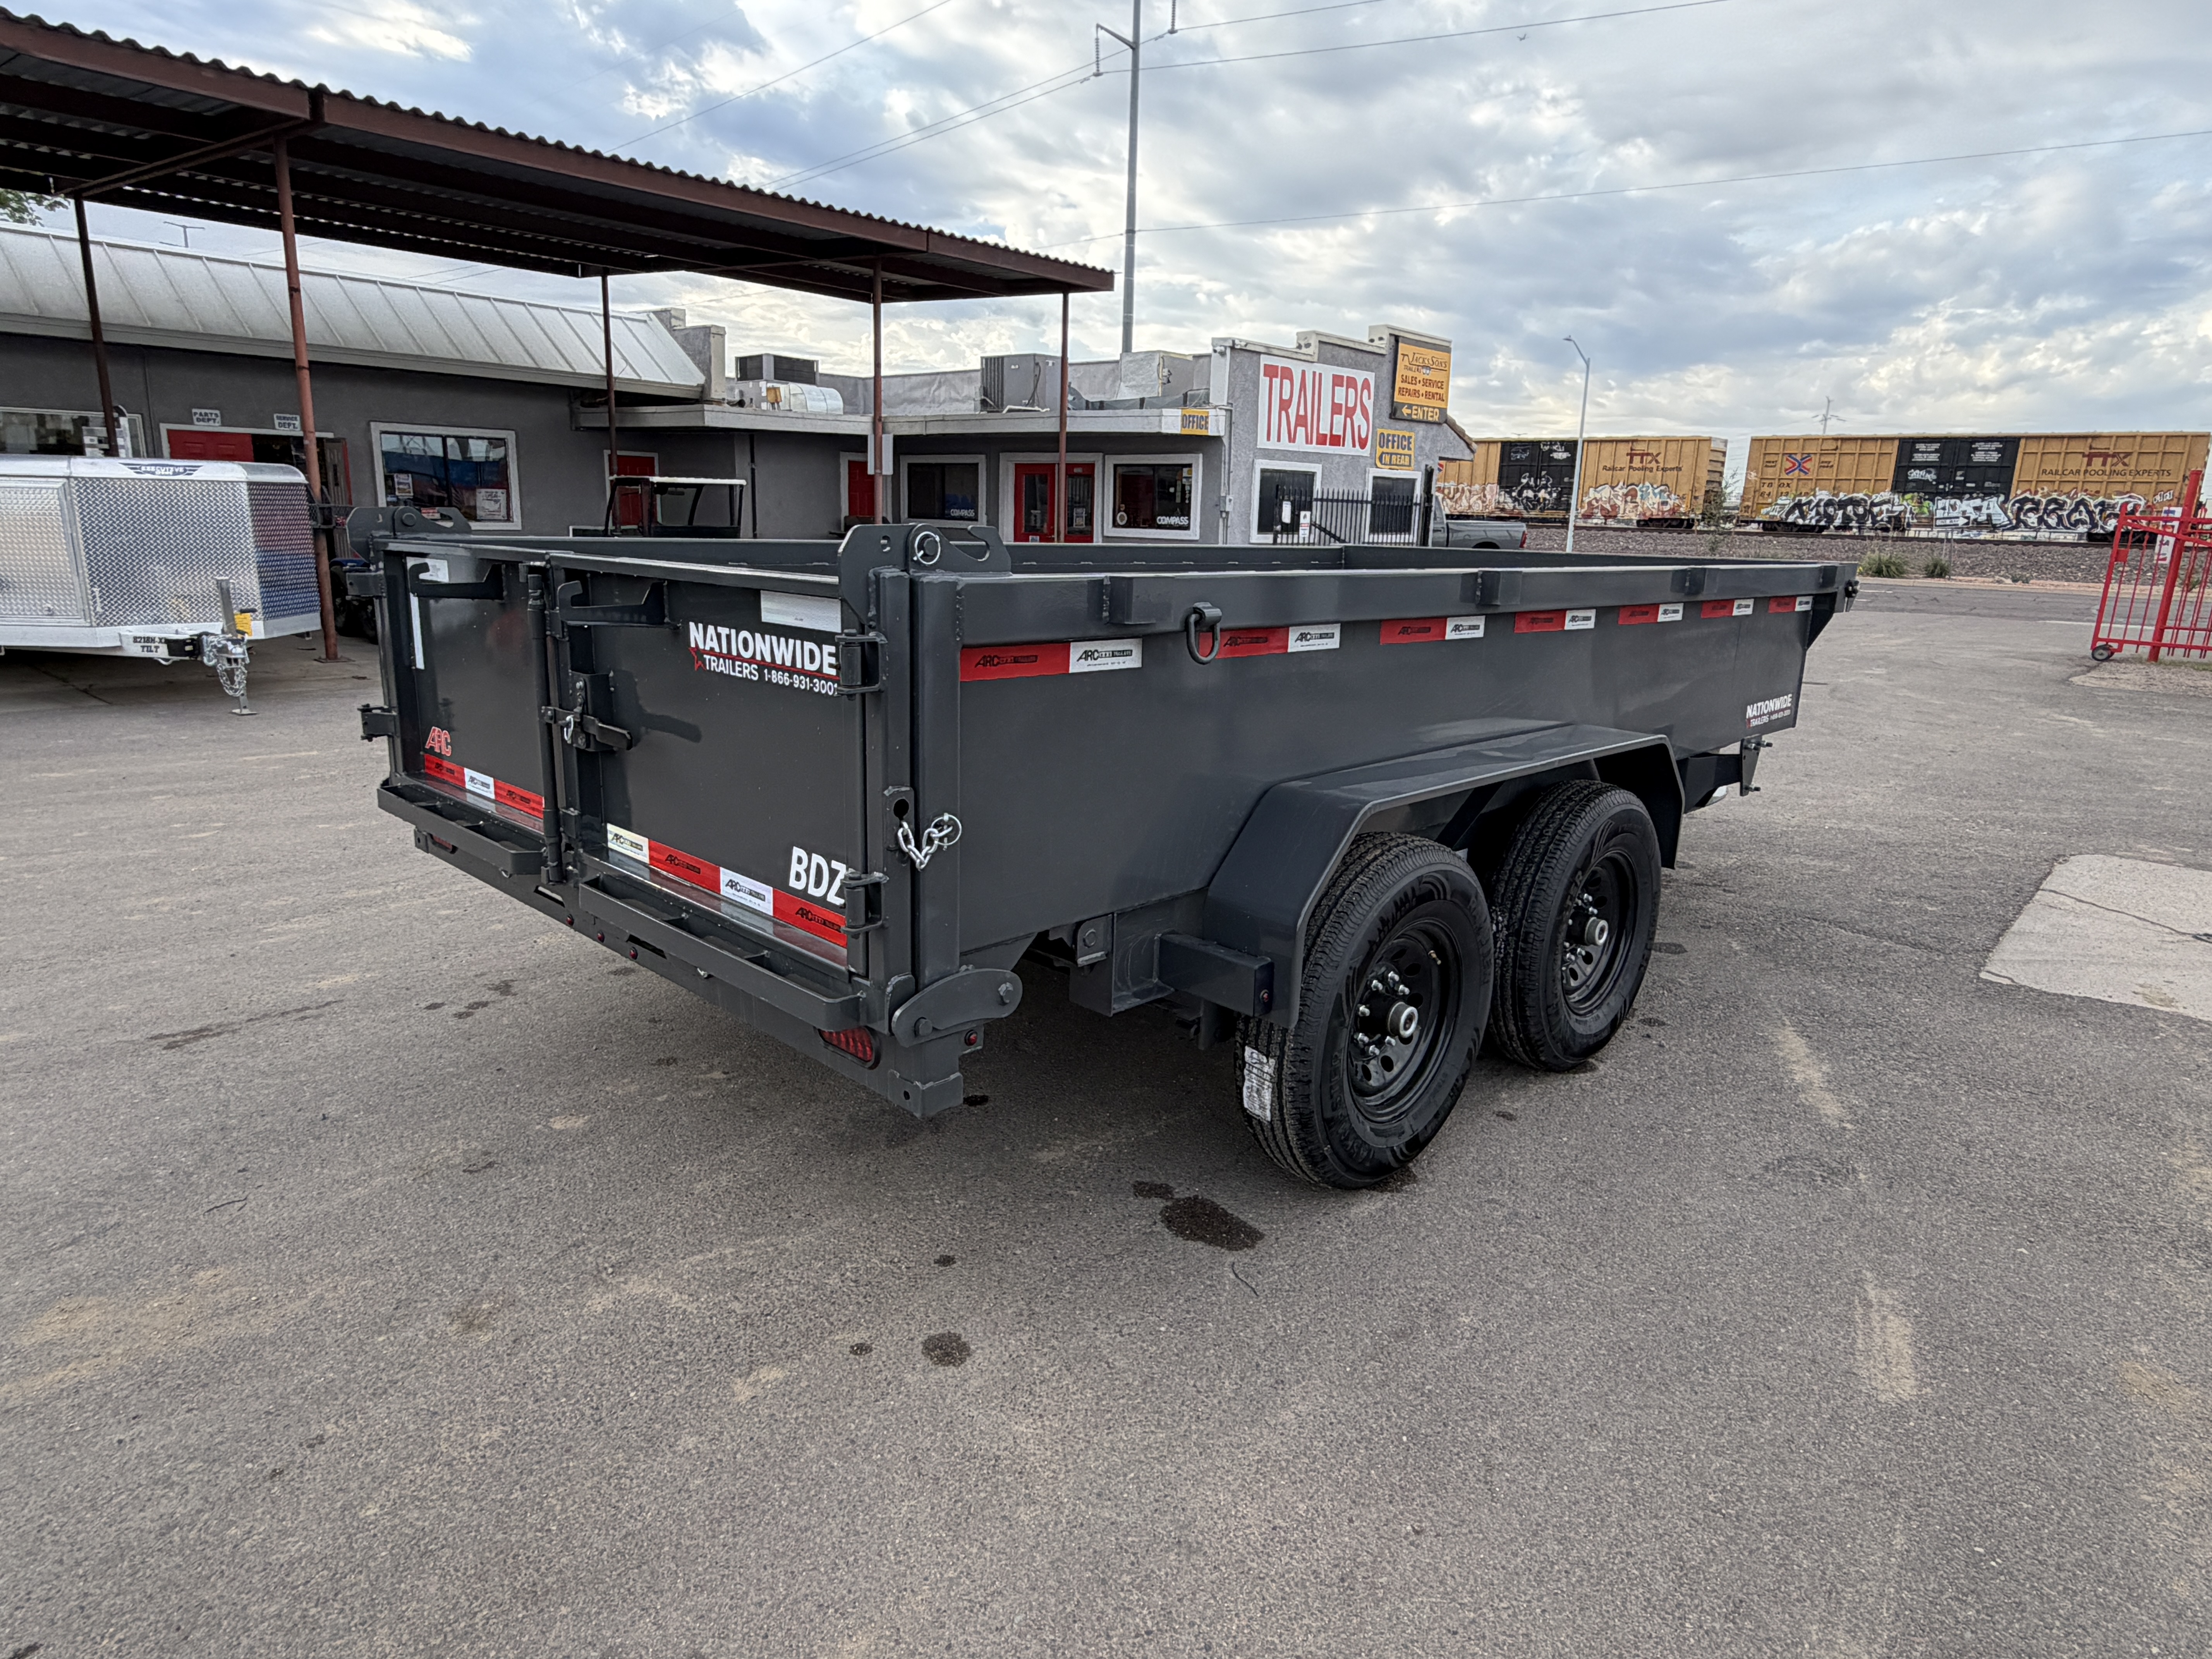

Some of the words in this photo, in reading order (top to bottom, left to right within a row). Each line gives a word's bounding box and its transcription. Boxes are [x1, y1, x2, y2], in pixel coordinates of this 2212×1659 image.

[1401, 374, 1417, 385] SALES
[1422, 378, 1444, 390] SERVICE
[1398, 387, 1420, 398] REPAIRS
[1424, 390, 1445, 402] RENTAL
[1263, 364, 1371, 450] TRAILERS
[1412, 405, 1439, 421] ENTER
[1182, 414, 1209, 430] OFFICE
[1379, 432, 1412, 451] OFFICE
[1382, 454, 1390, 464] IN
[1391, 455, 1410, 465] REAR
[1626, 452, 1661, 464] TTX
[2082, 452, 2133, 467] TTX
[1157, 516, 1189, 525] COMPASS
[689, 621, 837, 676] NATIONWIDE
[703, 654, 759, 681] TRAILERS
[1746, 693, 1792, 719] NATIONWIDE
[425, 726, 452, 756] ARC
[789, 846, 847, 905] BDZ
